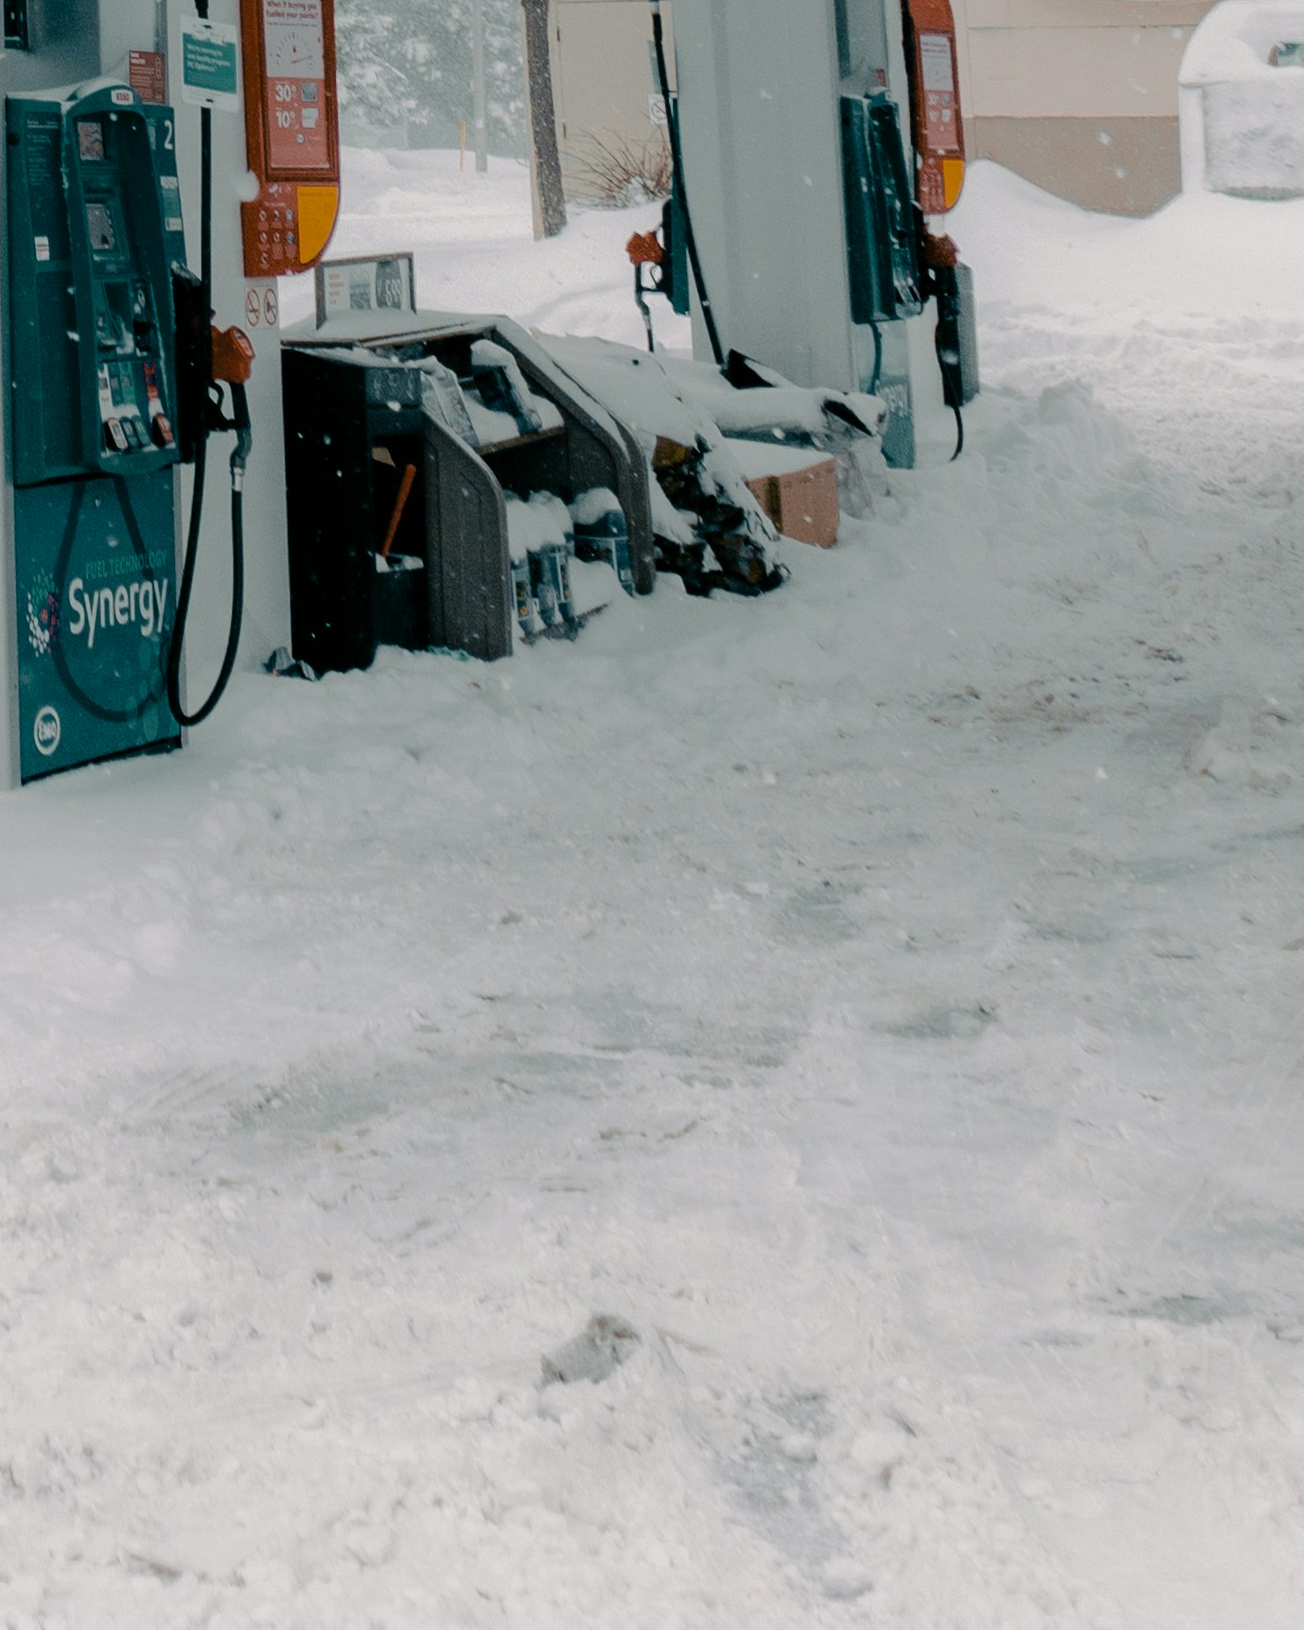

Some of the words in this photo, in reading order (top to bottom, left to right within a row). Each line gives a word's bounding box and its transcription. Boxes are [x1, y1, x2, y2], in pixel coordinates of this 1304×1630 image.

[164, 119, 174, 150] 2
[85, 559, 108, 580] FUEL
[110, 548, 168, 576] TECHNOLOGY
[68, 577, 169, 649] Synergy
